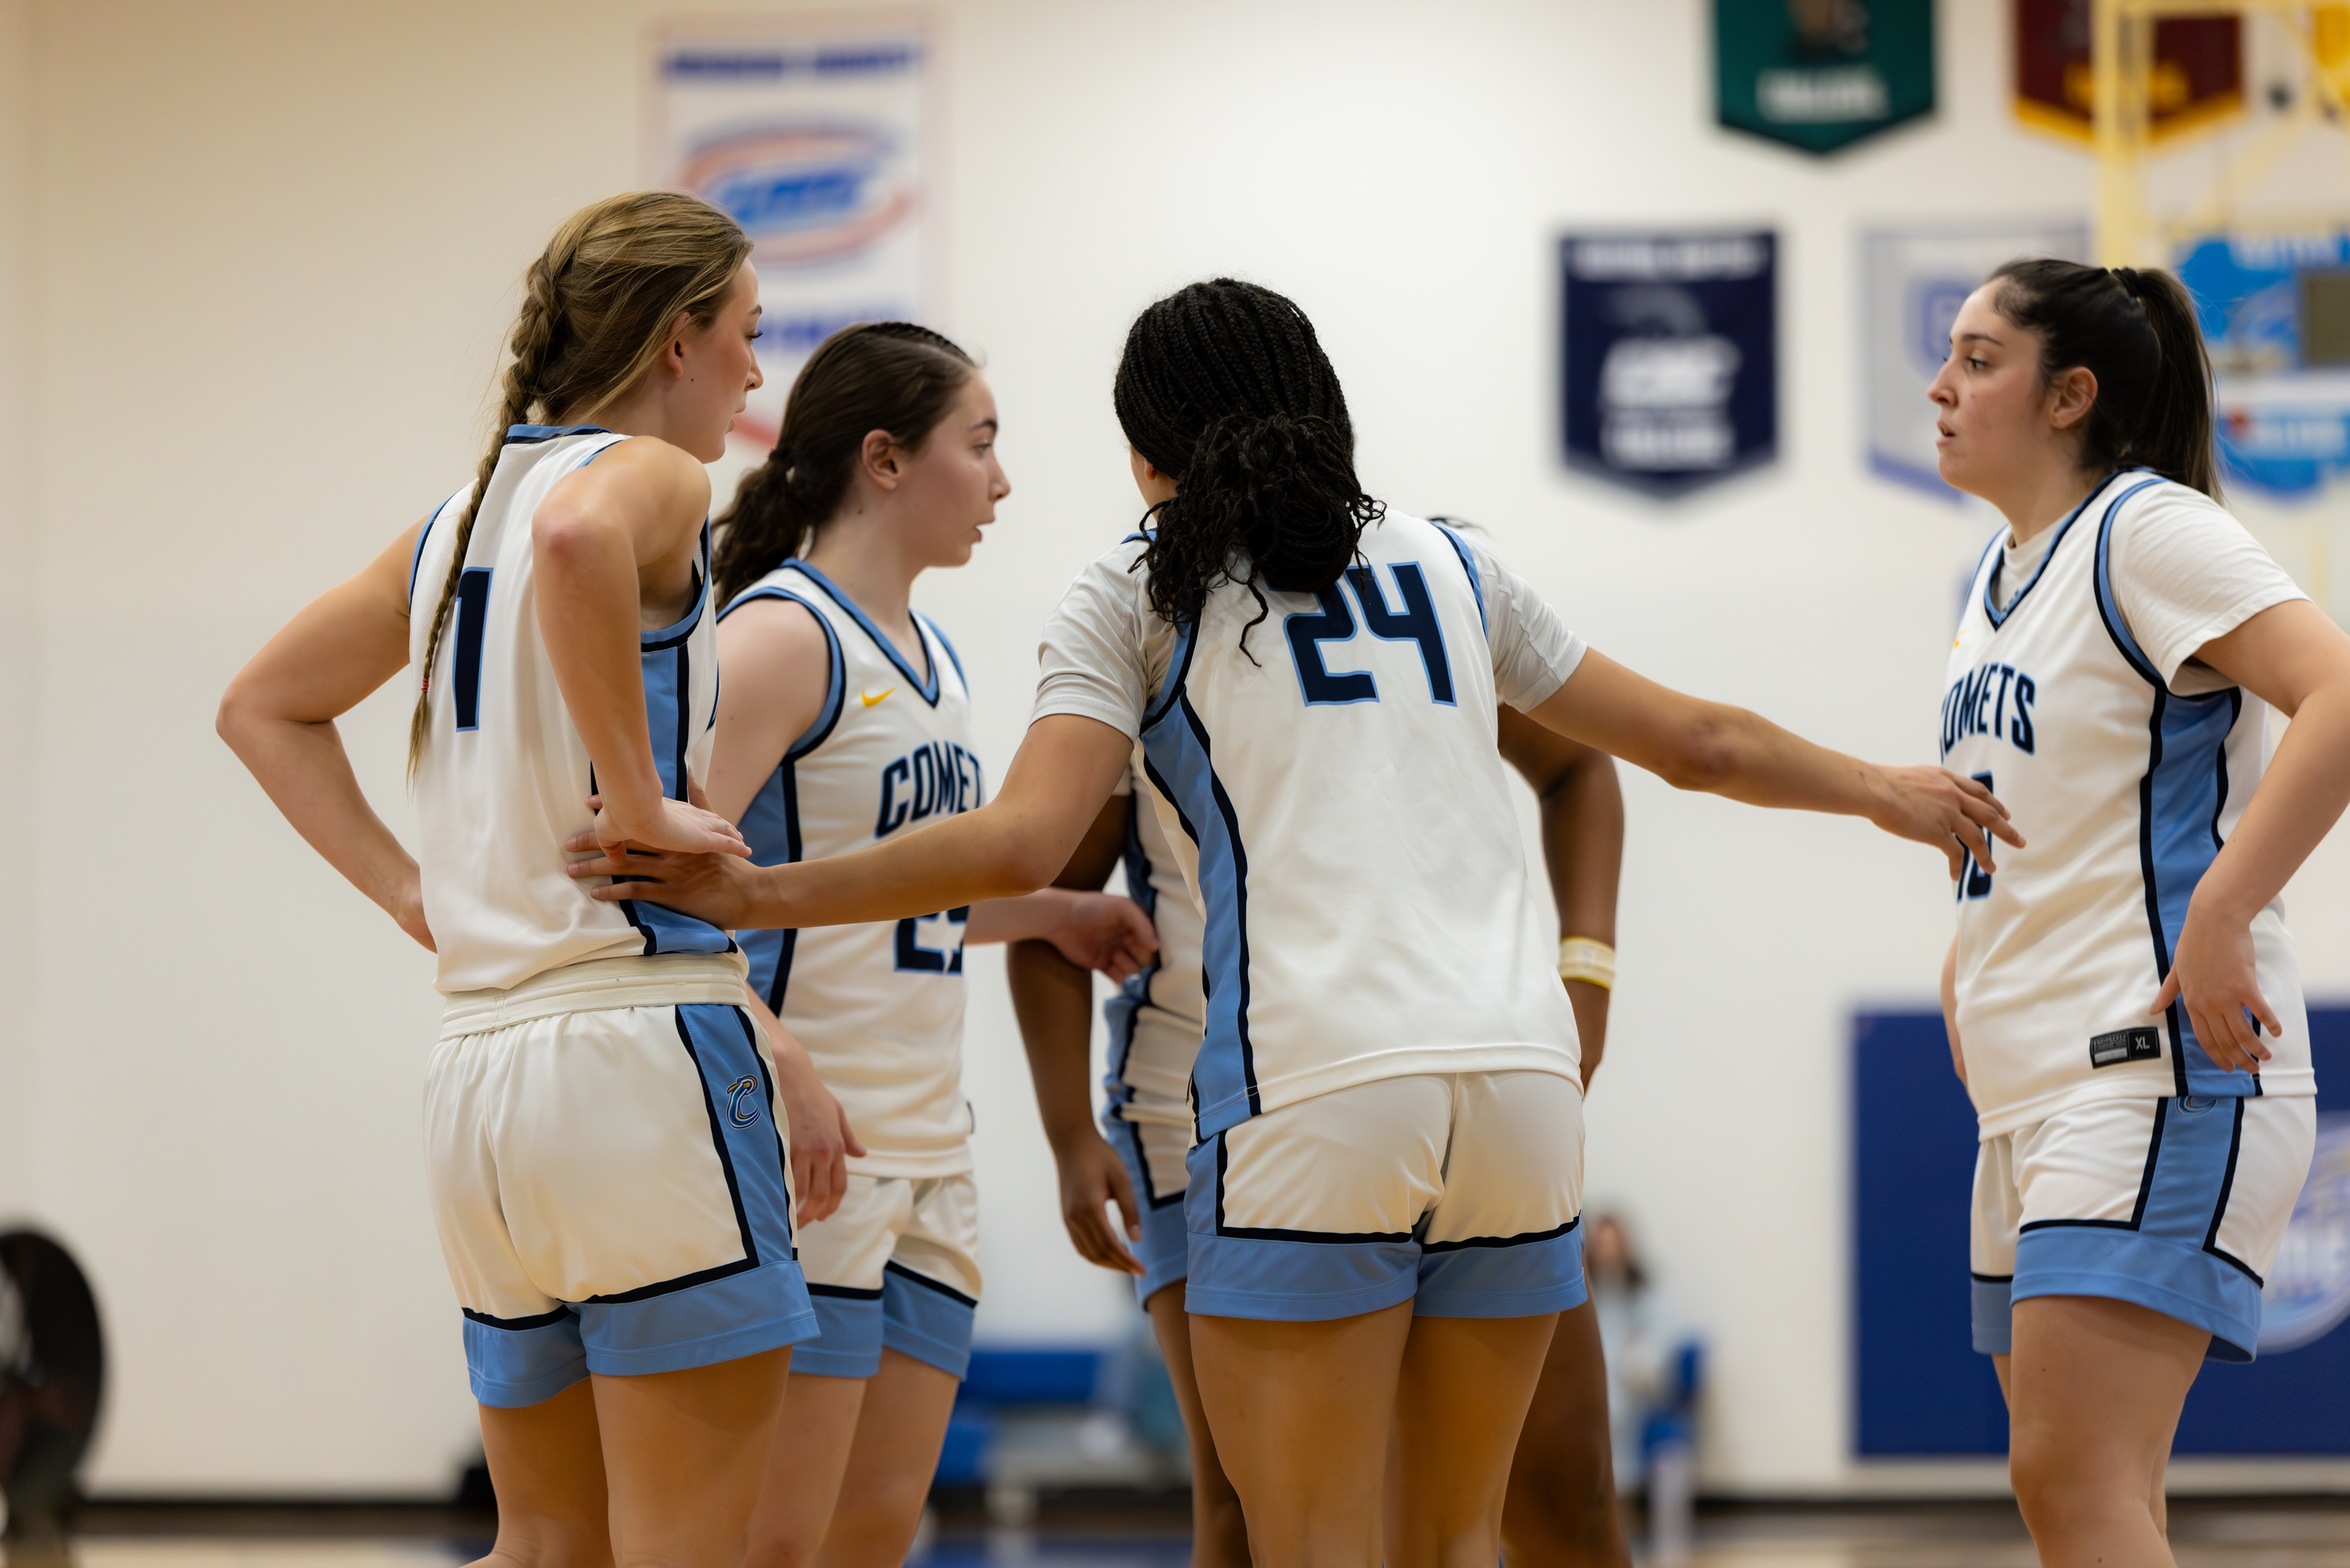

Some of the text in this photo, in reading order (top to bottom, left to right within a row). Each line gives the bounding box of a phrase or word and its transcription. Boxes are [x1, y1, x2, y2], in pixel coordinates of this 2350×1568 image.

[452, 567, 494, 733] 1
[1265, 561, 1458, 707] 24
[874, 741, 982, 839] COMET
[893, 905, 970, 976] 2
[2134, 1036, 2151, 1051] XL
